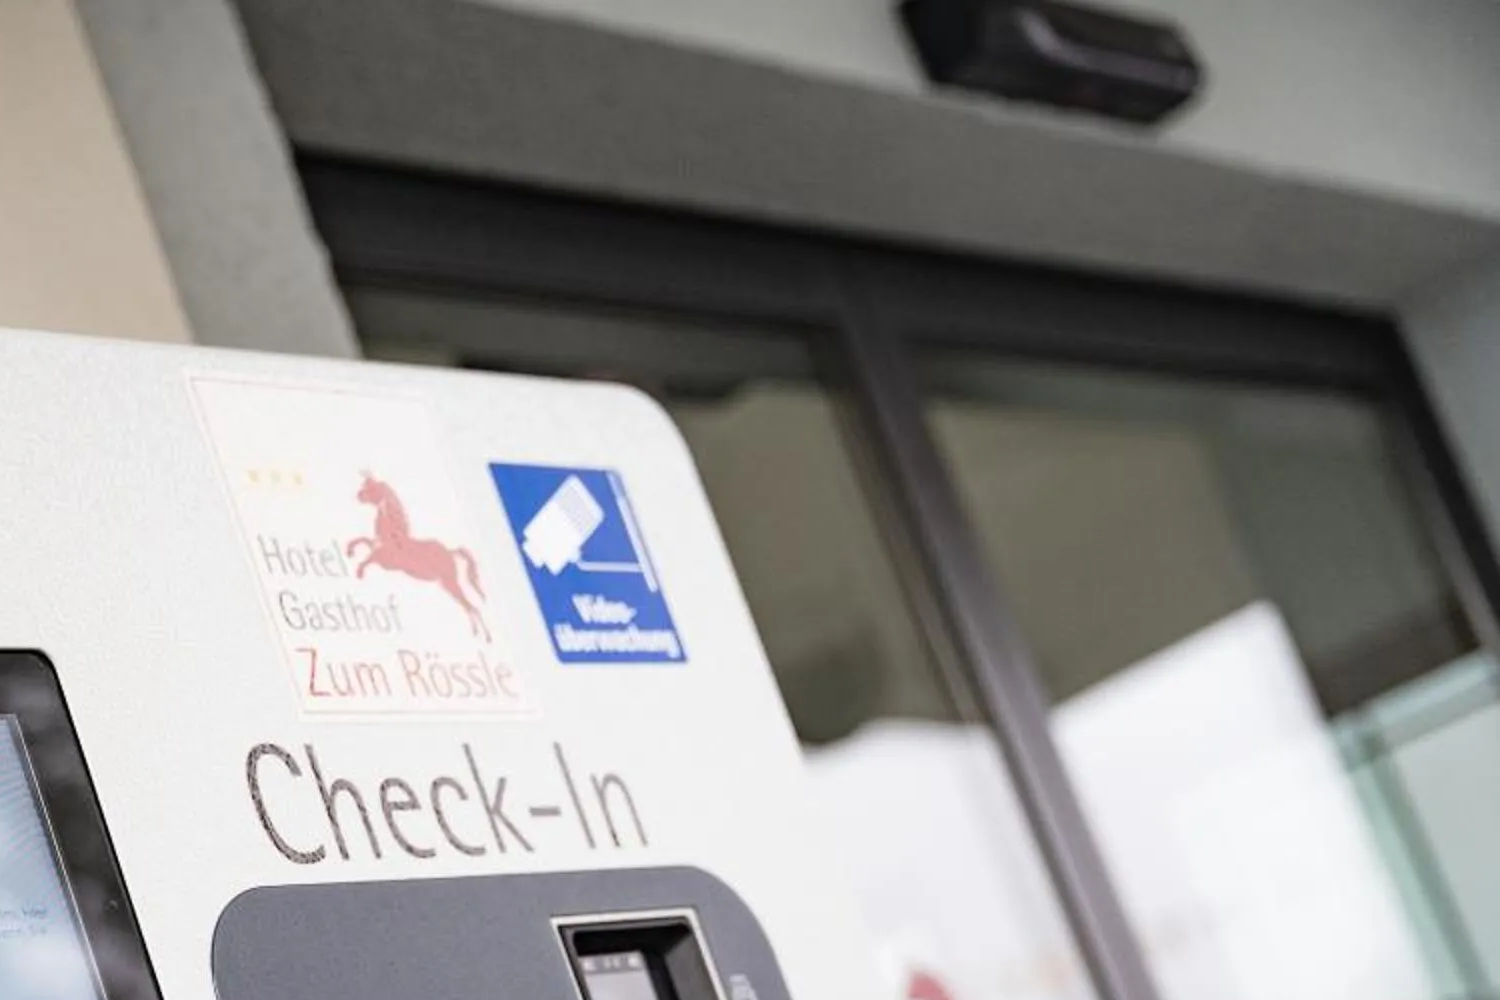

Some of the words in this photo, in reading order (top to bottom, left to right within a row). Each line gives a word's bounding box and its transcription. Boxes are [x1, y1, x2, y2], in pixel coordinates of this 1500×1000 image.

[257, 533, 350, 578] Hotel
[278, 589, 402, 633] Gasthof
[295, 648, 392, 698] Zum
[397, 648, 520, 698] Rössle
[246, 741, 649, 865] Check-In
